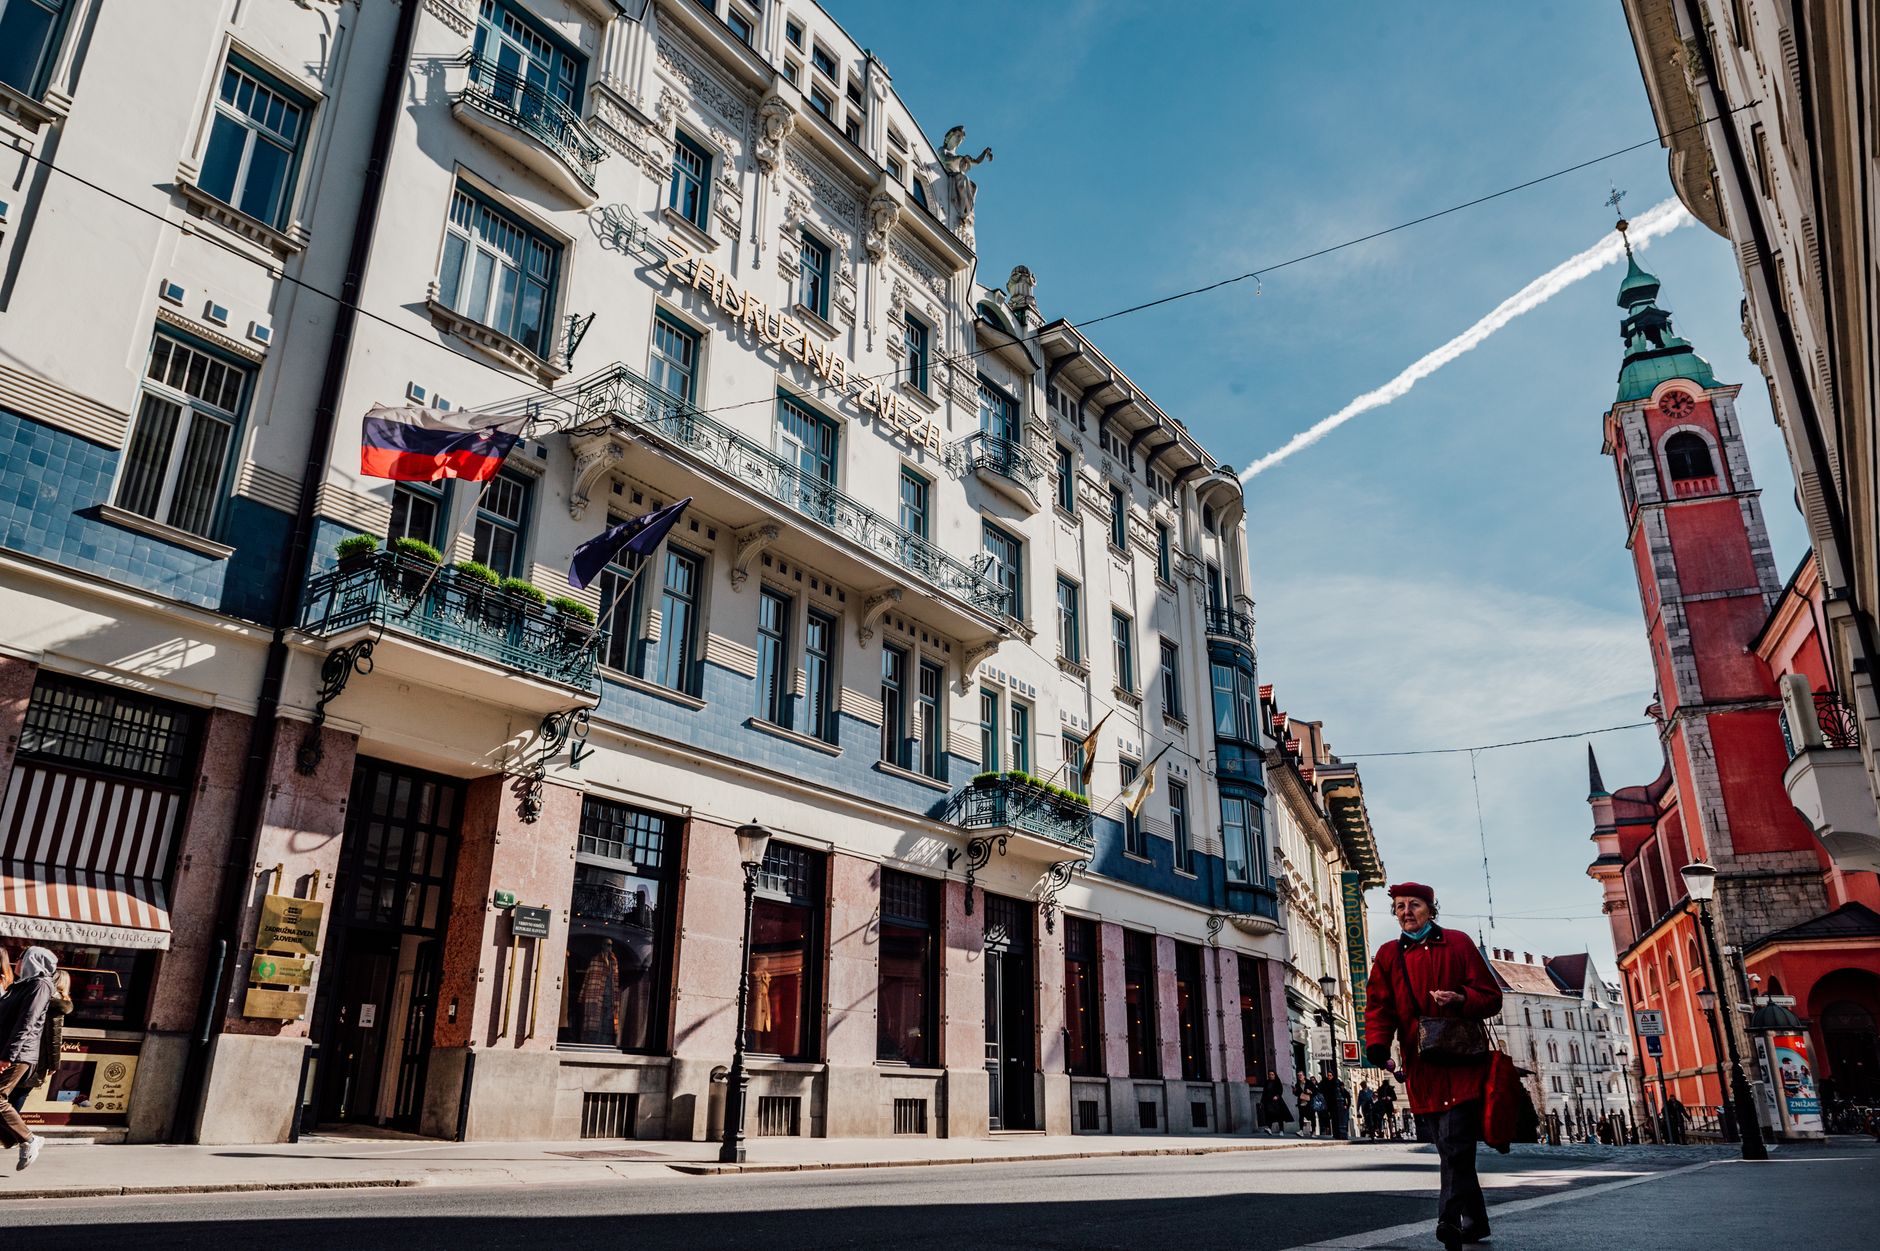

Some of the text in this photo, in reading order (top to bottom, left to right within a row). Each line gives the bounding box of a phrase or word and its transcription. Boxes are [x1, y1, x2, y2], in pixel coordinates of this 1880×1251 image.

[666, 236, 942, 456] ZADRUŽNA ZVEZA
[1, 921, 72, 935] CHOCOLATE
[264, 925, 314, 938] ZADRUŽNA ZVEZA
[1344, 882, 1364, 973] EMPORIUM
[273, 934, 303, 943] SLOVENIJE
